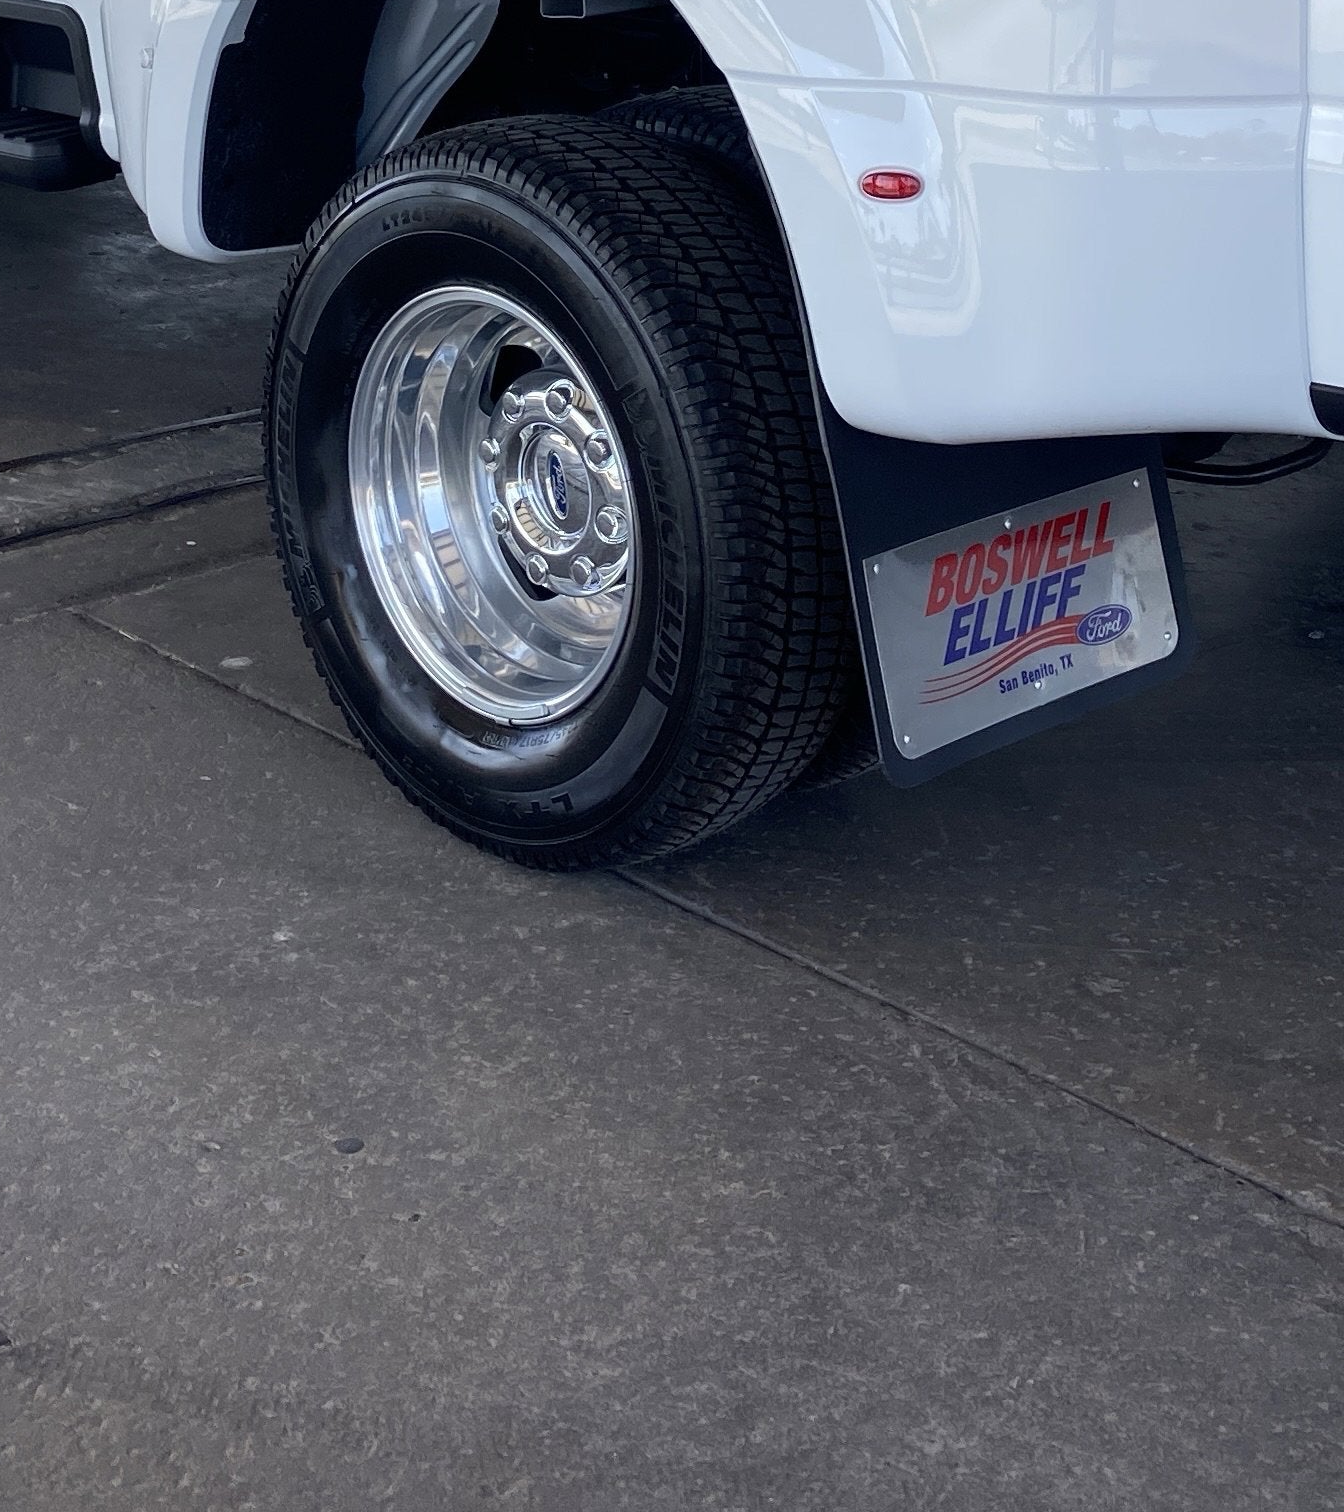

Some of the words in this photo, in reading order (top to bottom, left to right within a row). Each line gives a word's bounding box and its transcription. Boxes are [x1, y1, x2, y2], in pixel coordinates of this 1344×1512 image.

[924, 501, 1114, 617] BOSWELL
[943, 564, 1087, 667] ELLIFF
[999, 677, 1019, 695] San
[1021, 662, 1059, 686] Benito,
[1059, 652, 1075, 671] TX
